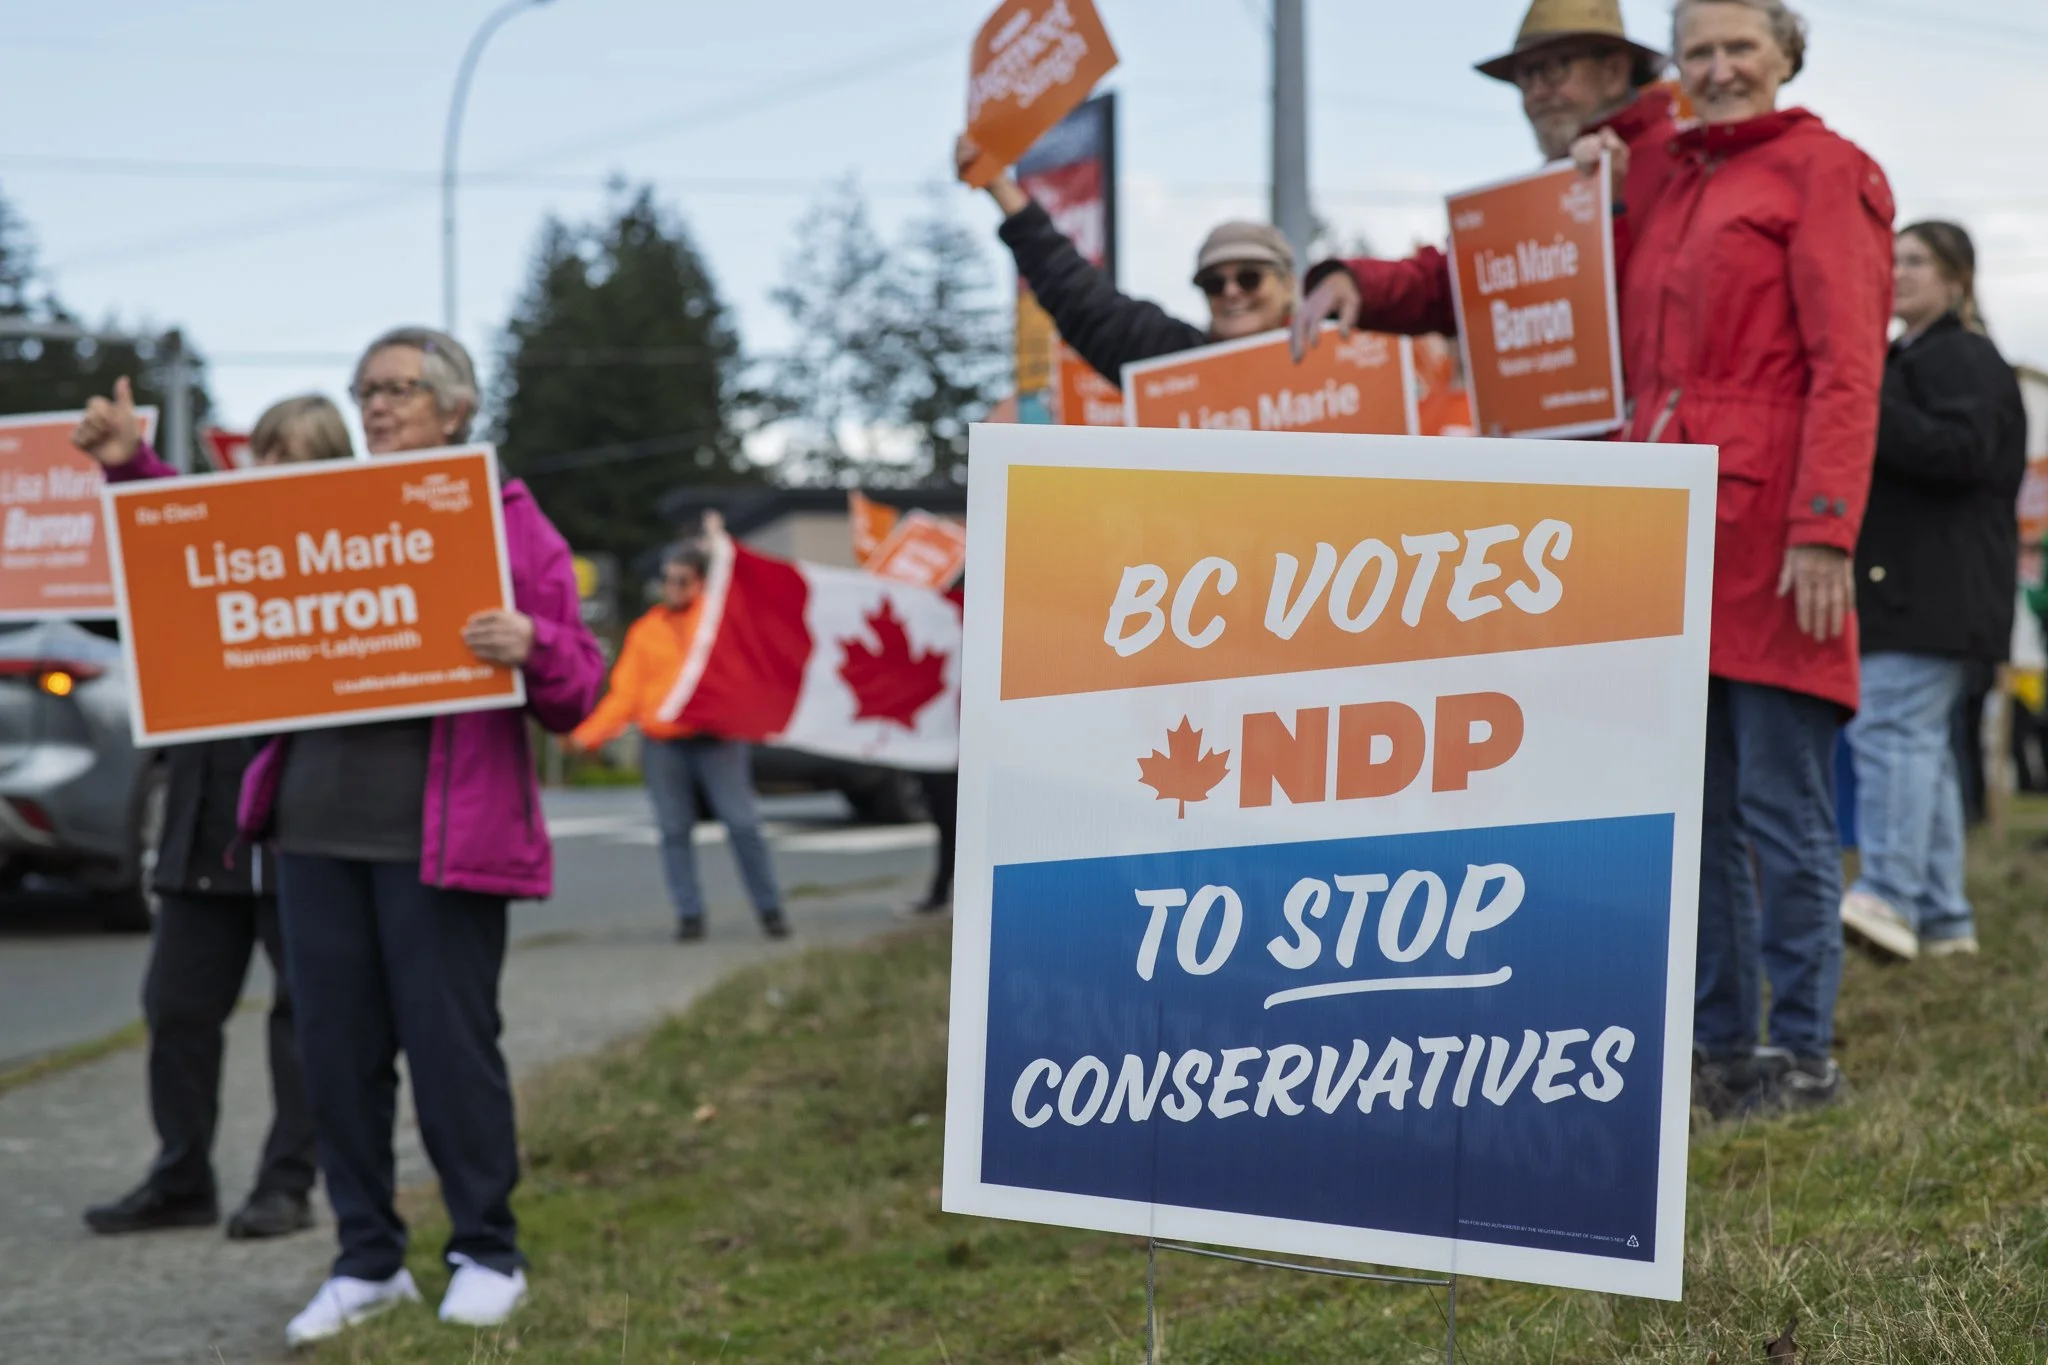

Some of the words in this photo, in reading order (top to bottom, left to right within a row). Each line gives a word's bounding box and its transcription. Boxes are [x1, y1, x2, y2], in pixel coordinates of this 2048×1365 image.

[1517, 234, 1578, 286] Marie
[1491, 298, 1574, 353] Barron
[1258, 378, 1360, 431] Marie
[47, 463, 105, 501] Mari
[184, 540, 286, 588] Lisa
[295, 520, 434, 576] Marie
[215, 583, 418, 645] Barron
[1103, 556, 1238, 658] BC
[1263, 518, 1573, 641] VOTES
[1239, 692, 1524, 808] NDP
[1134, 884, 1243, 982] TO
[1266, 863, 1526, 970] STOP
[1011, 1025, 1636, 1128] CONSERVATIVES
